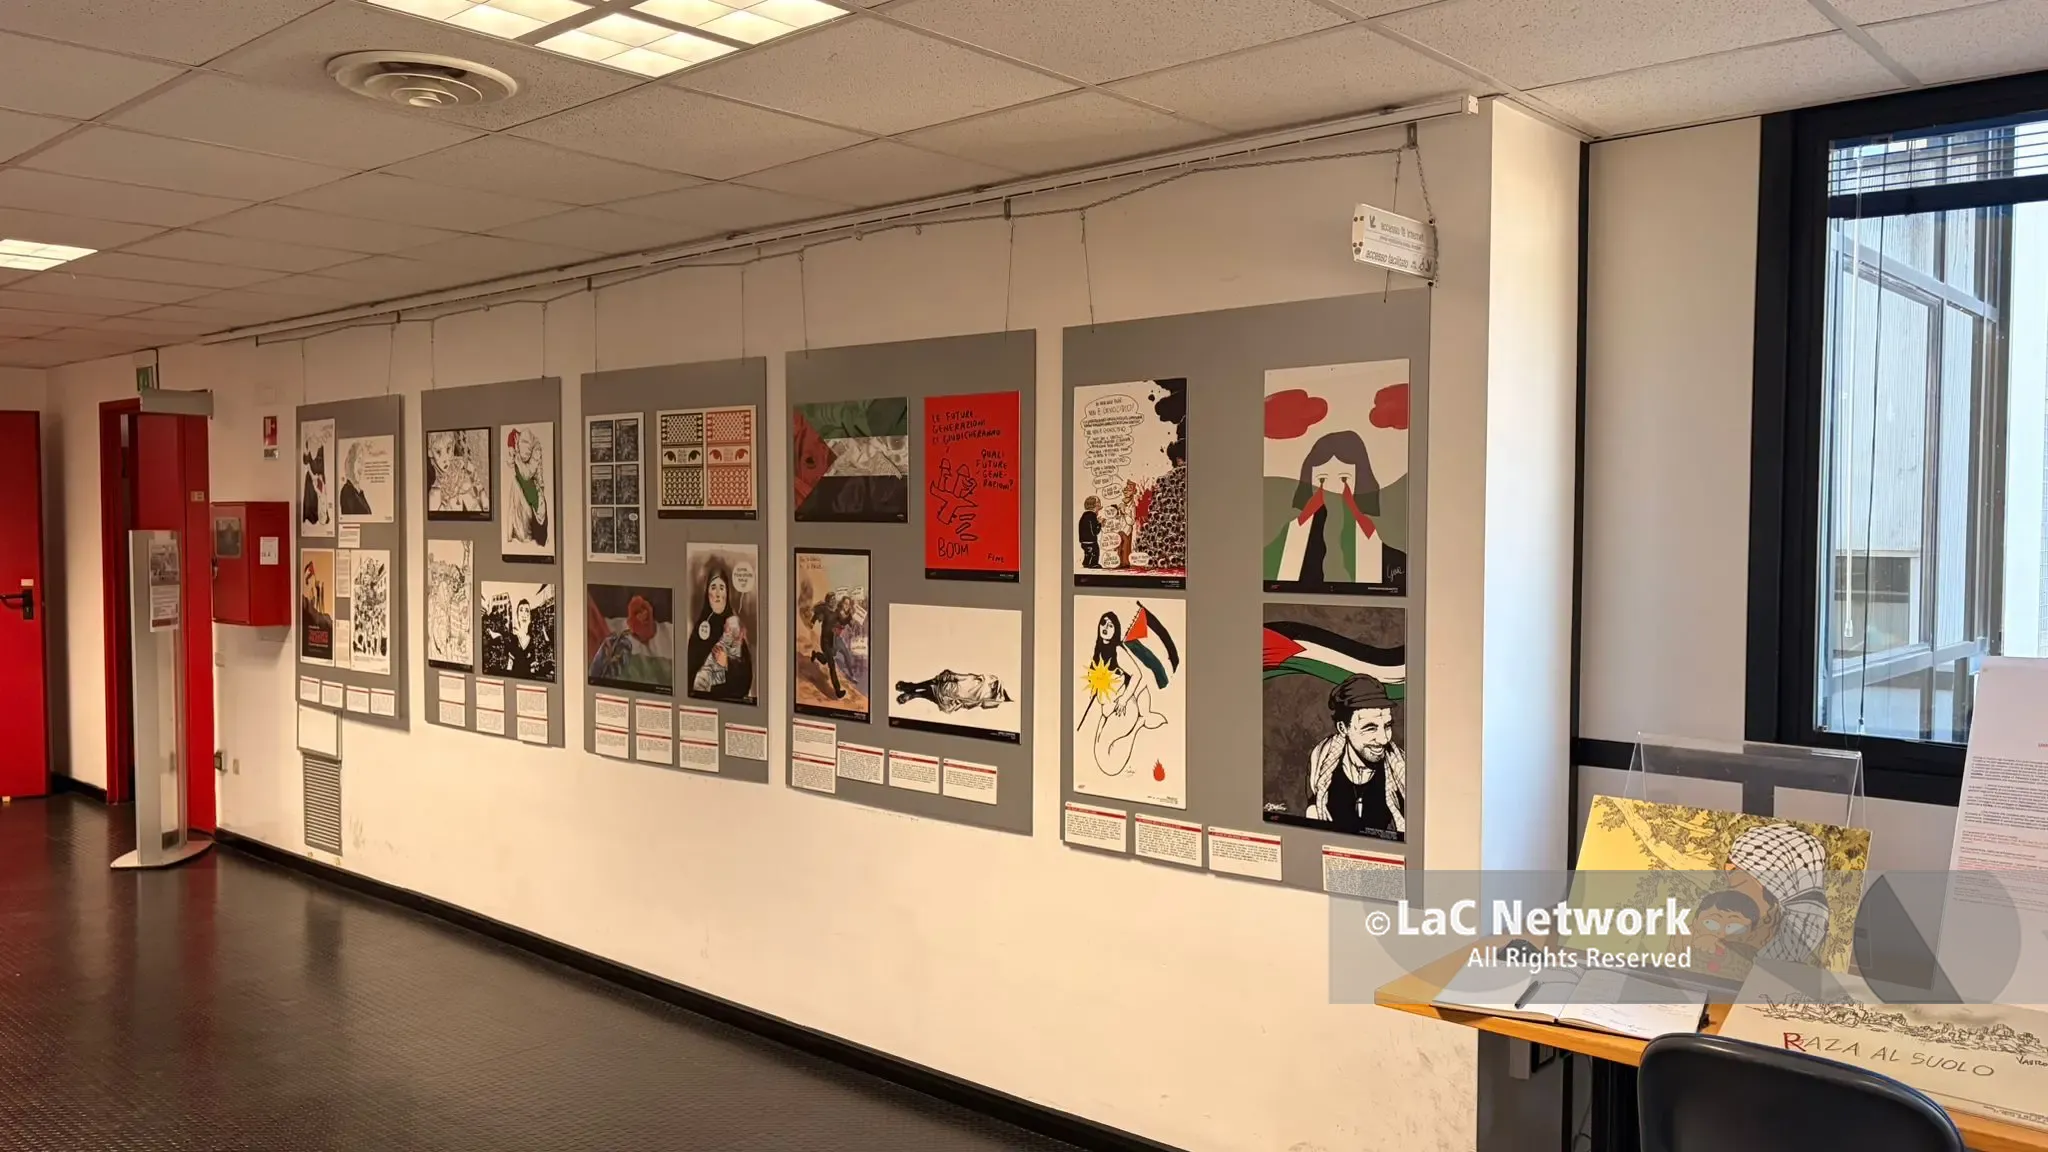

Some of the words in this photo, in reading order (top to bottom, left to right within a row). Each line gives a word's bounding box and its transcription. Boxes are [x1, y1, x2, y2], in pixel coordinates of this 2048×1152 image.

[946, 410, 973, 421] FUTURE
[932, 420, 986, 434] GENERAZIONI
[943, 429, 1001, 445] GIUDICHERANNO
[976, 459, 1008, 470] FUTURE
[937, 536, 969, 559] BOOM
[1870, 1046, 1901, 1062] AL
[1910, 1052, 1995, 1077] SUOLO
